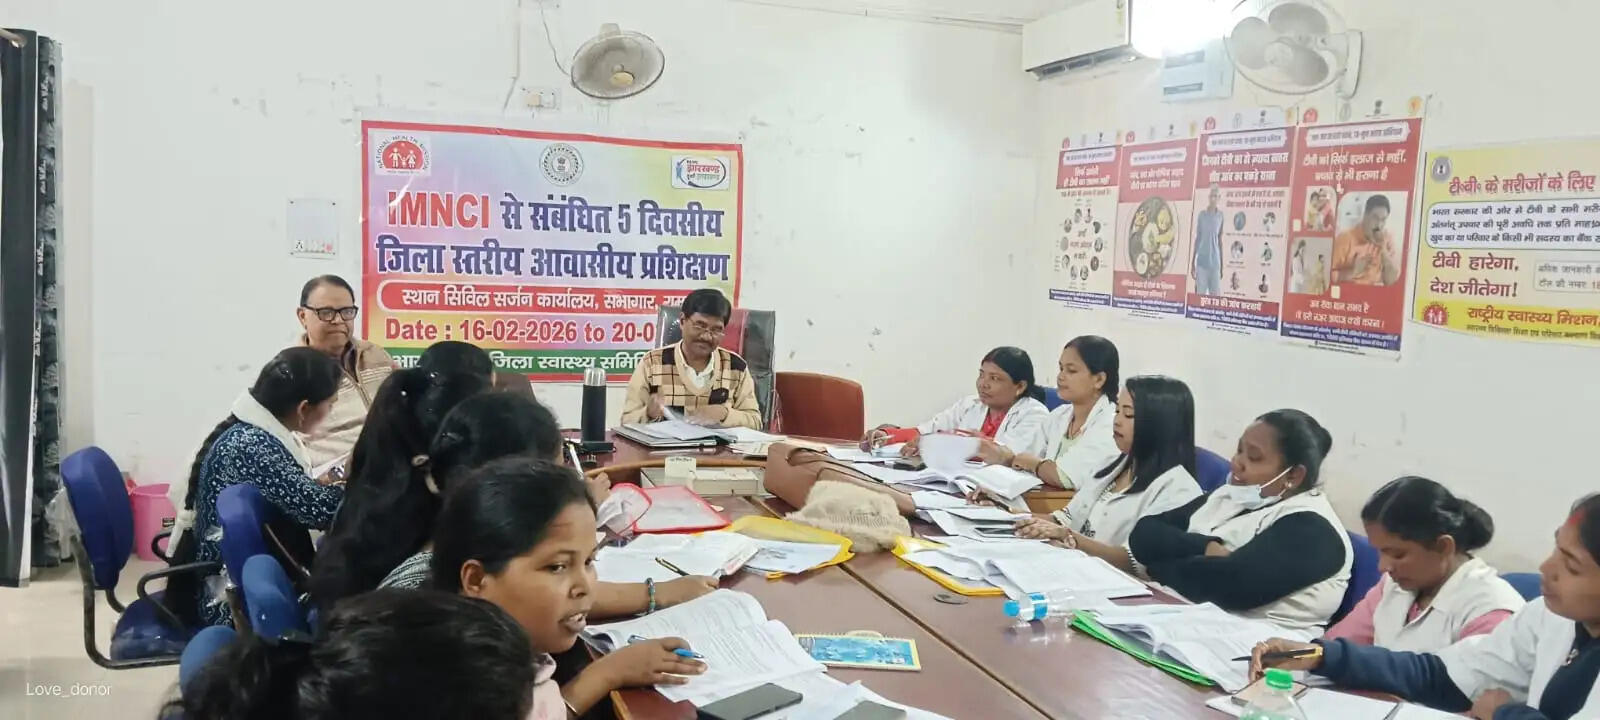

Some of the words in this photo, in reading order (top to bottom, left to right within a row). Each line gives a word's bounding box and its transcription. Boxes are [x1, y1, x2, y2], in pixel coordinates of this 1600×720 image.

[1484, 175, 1499, 193] के
[1503, 172, 1546, 193] मरीजों
[1548, 172, 1563, 191] के
[1568, 171, 1596, 191] लिए
[388, 191, 489, 228] IMNCI
[500, 192, 524, 230] से
[528, 194, 613, 234] संबंधित
[618, 204, 631, 234] 5
[637, 200, 725, 237] दिवसीय
[376, 235, 446, 273] जिला
[451, 238, 524, 275] स्तरीय
[531, 243, 636, 279] आवासीय
[640, 245, 730, 281] प्रशिक्षण
[1430, 277, 1455, 293] देश
[402, 289, 440, 305] स्थान
[444, 285, 490, 306] सिविल
[494, 286, 533, 307] सर्जन
[537, 288, 599, 310] कार्यालय,
[1468, 305, 1504, 323] राष्ट्रीय
[1507, 310, 1552, 324] स्वास्थ्य
[386, 318, 438, 340] Date
[445, 325, 451, 340] :
[460, 319, 577, 342] 16-02-2026
[585, 323, 605, 342] to
[612, 322, 655, 343] 20-0
[489, 351, 533, 369] जिला
[538, 355, 596, 369] स्वास्थ्य
[600, 352, 647, 369] समि
